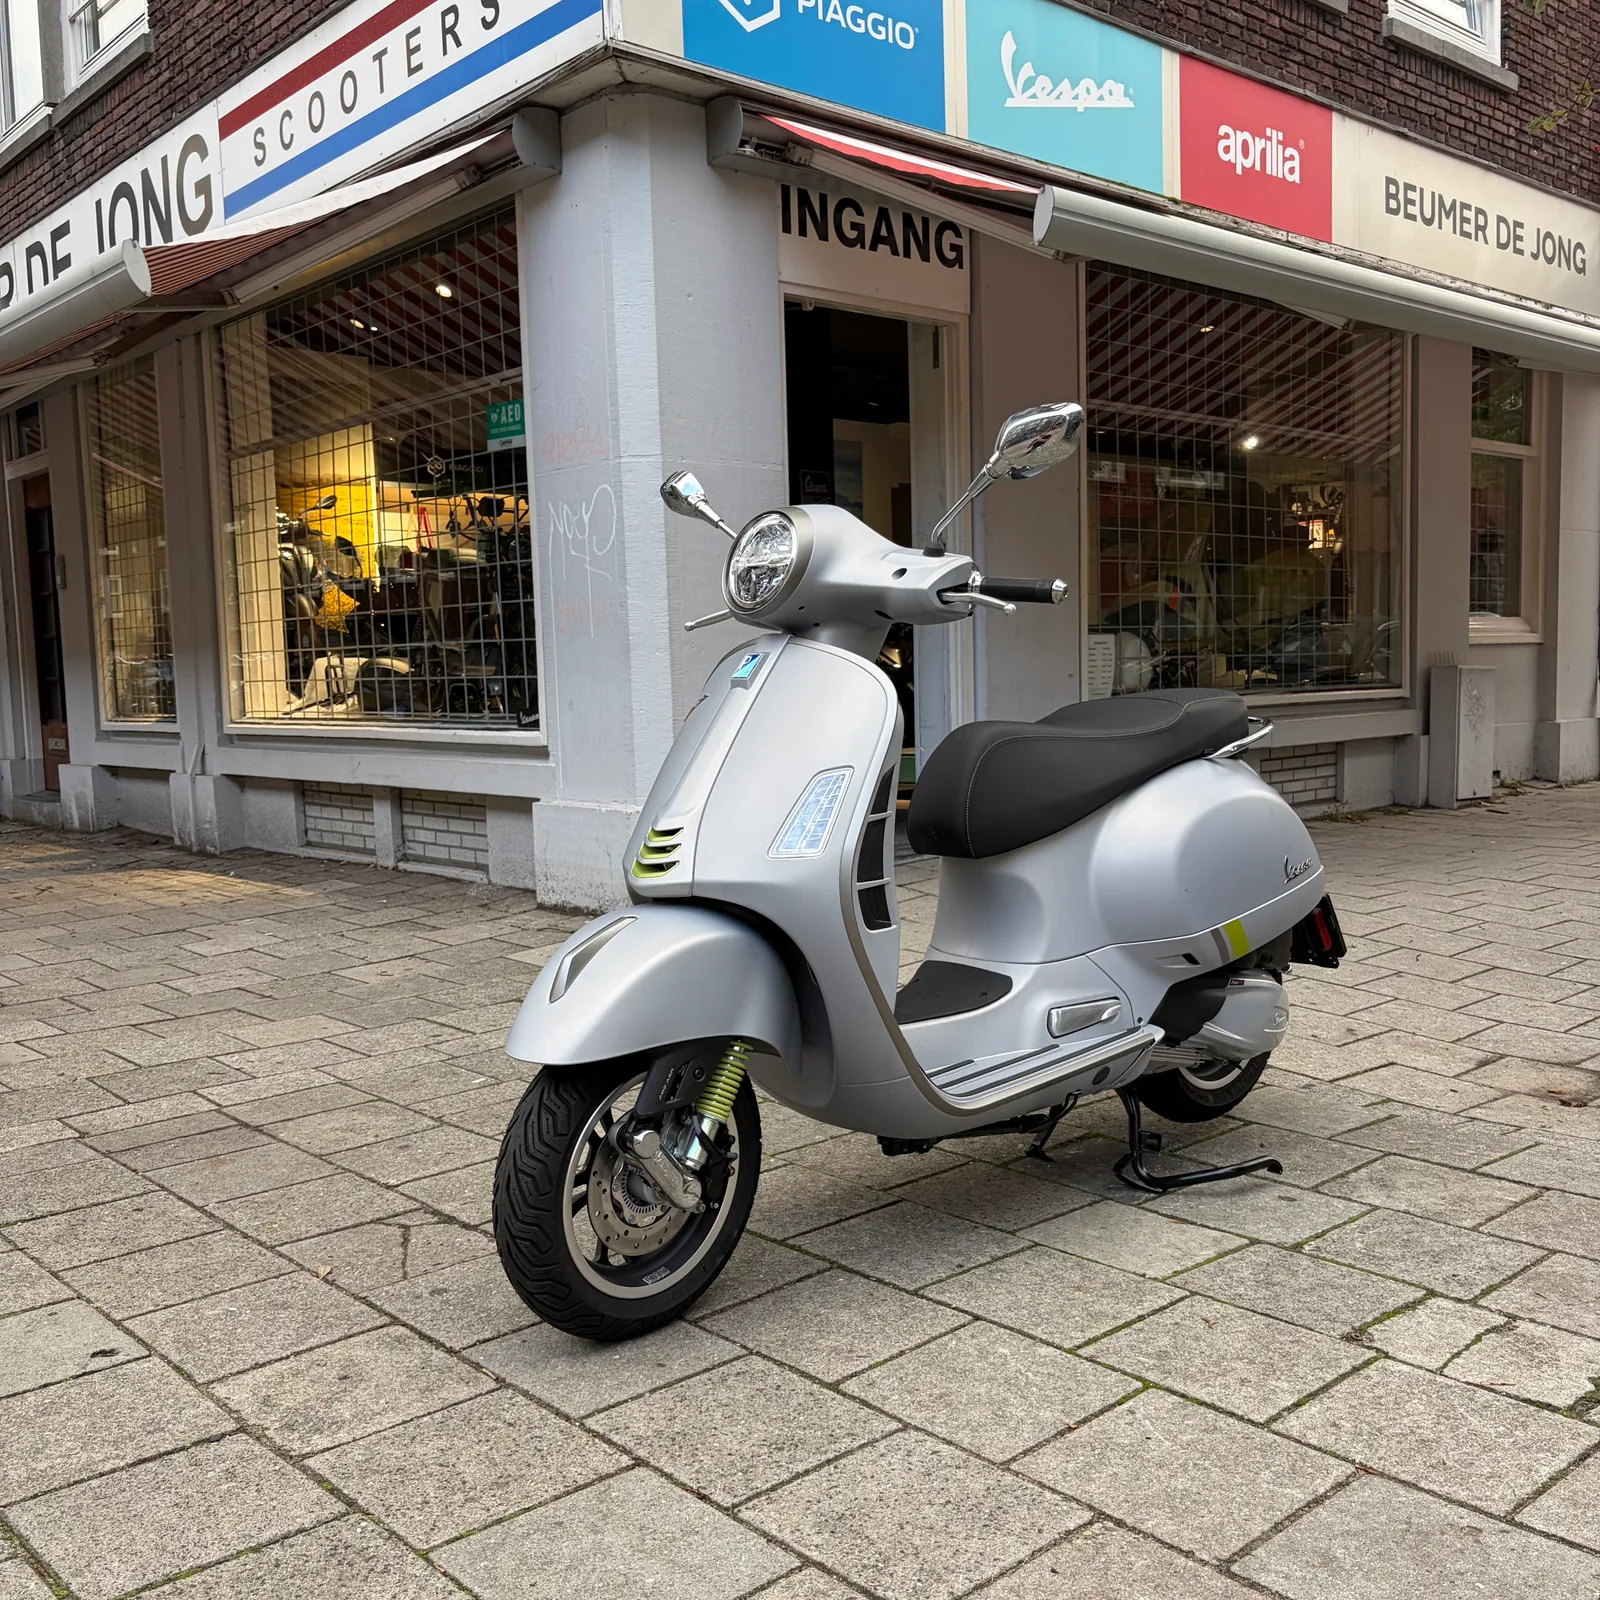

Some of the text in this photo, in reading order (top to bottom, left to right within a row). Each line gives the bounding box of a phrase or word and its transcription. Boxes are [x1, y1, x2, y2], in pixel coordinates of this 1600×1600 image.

[253, 0, 500, 167] SCOOTERS
[1001, 30, 1135, 112] Vespa
[1217, 124, 1301, 184] aprilia
[780, 183, 965, 271] INGANG
[1384, 176, 1587, 277] BEUMER DE JONG
[501, 403, 521, 424] AED
